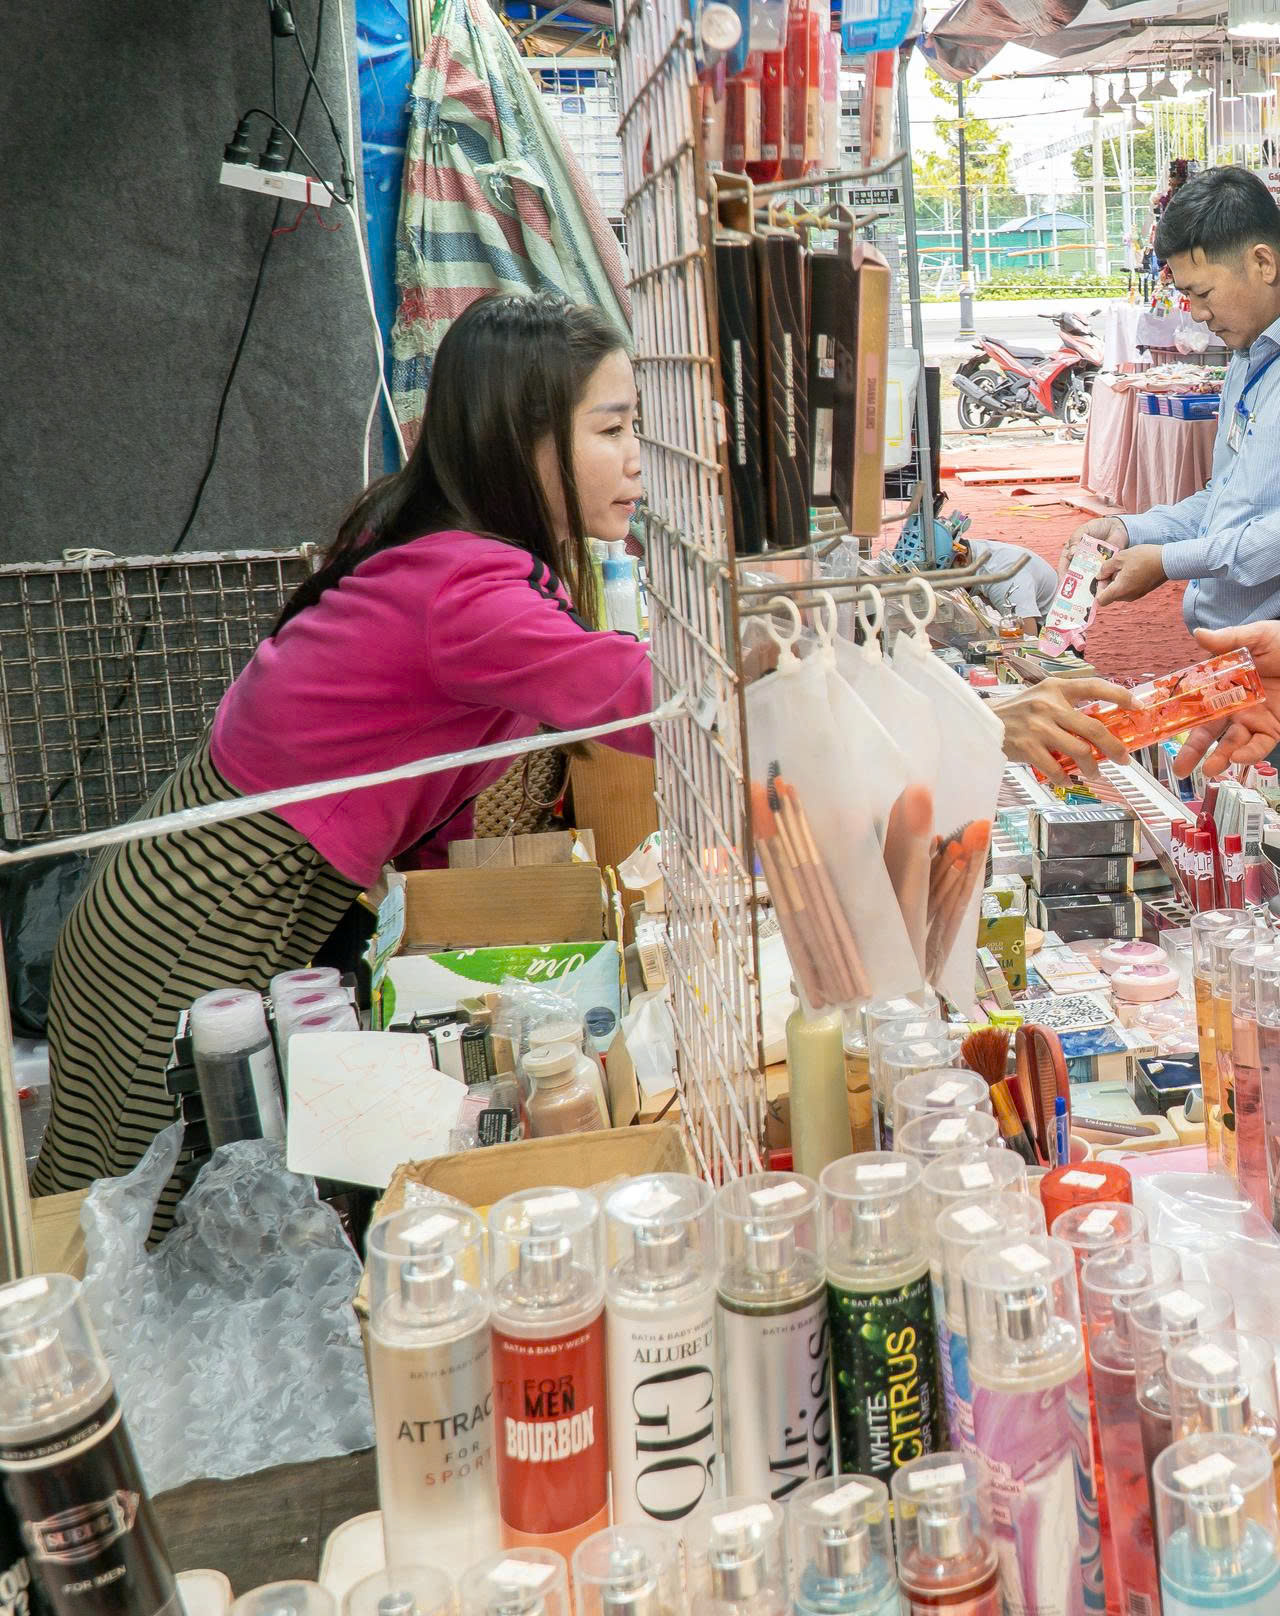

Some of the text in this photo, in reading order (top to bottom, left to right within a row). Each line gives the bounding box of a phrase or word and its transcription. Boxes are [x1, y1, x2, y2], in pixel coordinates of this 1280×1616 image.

[1197, 857, 1213, 871] LIP
[632, 1336, 703, 1364] ALLURE
[524, 1390, 576, 1418] MEN
[886, 1326, 924, 1467] CITRUS
[505, 1405, 595, 1464] BOURBON
[866, 1395, 891, 1472] WHITE
[445, 1440, 480, 1464] FOR
[95, 1563, 128, 1585] MEN
